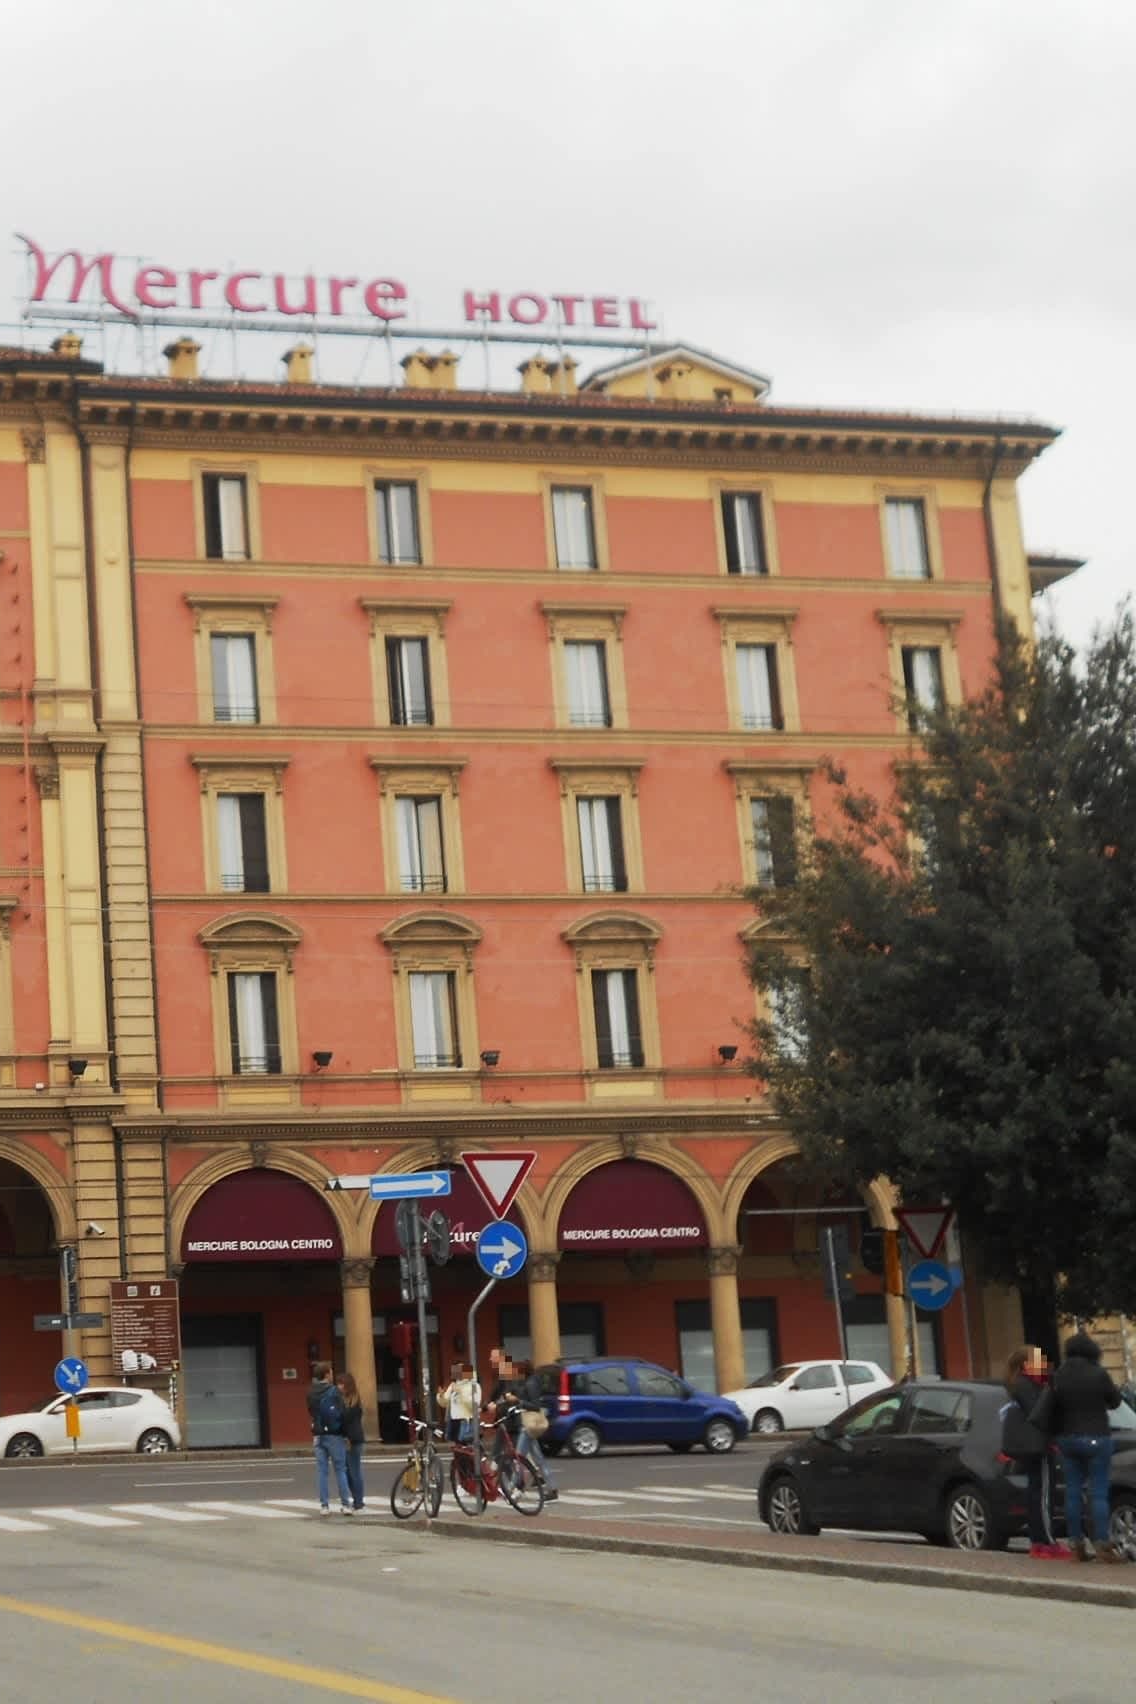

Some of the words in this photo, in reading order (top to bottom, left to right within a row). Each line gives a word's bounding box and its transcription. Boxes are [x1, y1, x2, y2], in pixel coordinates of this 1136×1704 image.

[14, 233, 407, 326] Mercure
[464, 291, 657, 329] HOTEL
[563, 1230, 610, 1240] MERCURE
[612, 1228, 659, 1239] BOLOGNA
[660, 1227, 700, 1237] CENTRO
[188, 1241, 239, 1251] MERCURE
[240, 1239, 290, 1250] BOLOGNA
[291, 1239, 333, 1249] CENTRO
